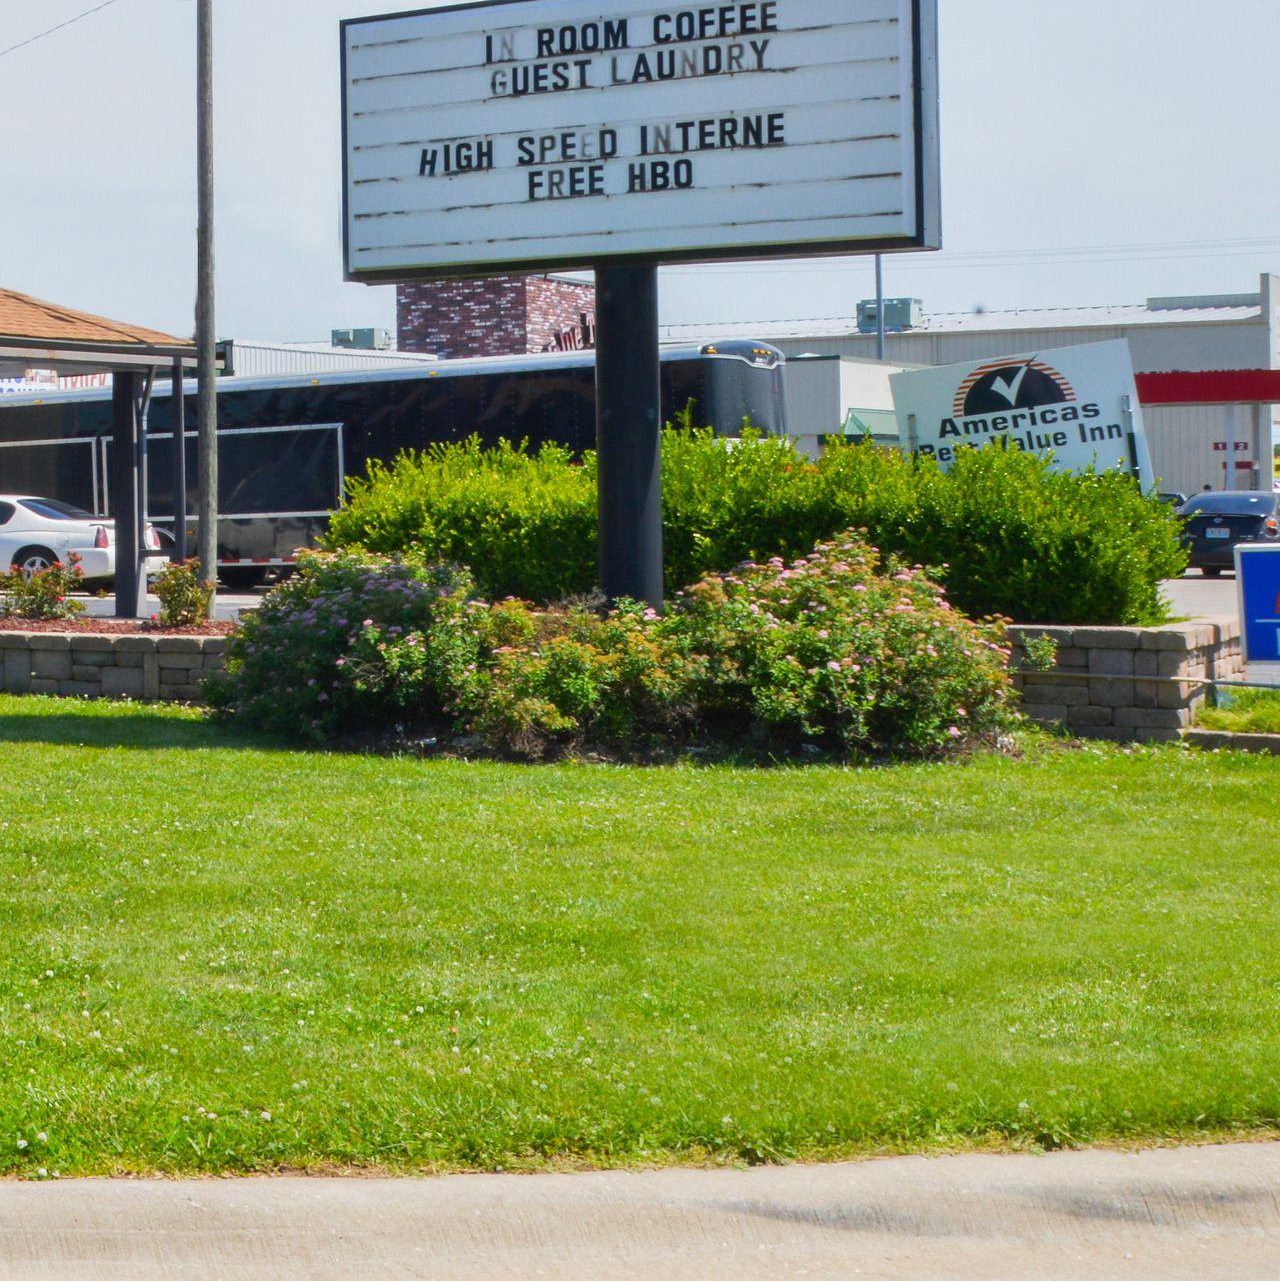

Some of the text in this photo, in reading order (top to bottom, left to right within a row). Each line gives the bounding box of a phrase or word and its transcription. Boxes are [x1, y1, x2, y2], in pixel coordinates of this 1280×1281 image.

[485, 1, 778, 64] IN ROOM COFFEE
[490, 39, 770, 97] GUEST LAUNDRY
[419, 112, 785, 176] HIGH SPEED INTERNE
[528, 158, 693, 201] FREE HBO
[938, 402, 1101, 439] Americas
[1078, 423, 1123, 443] Inn
